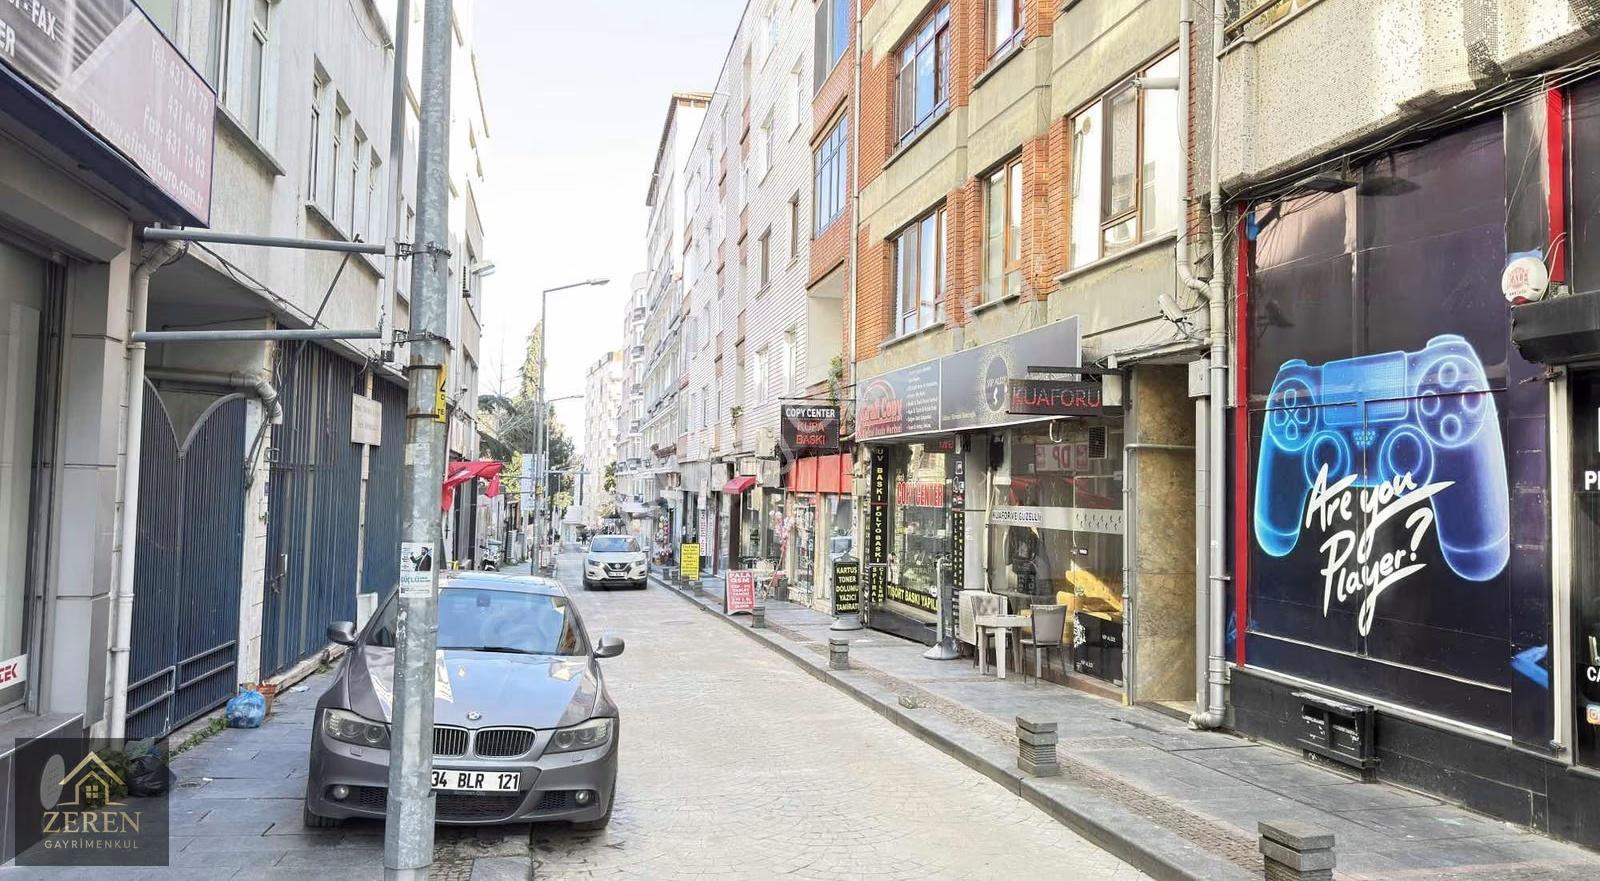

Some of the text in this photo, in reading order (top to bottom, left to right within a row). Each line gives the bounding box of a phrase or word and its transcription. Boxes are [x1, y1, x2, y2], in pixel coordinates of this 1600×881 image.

[32, 0, 56, 40] FAX
[785, 408, 836, 418] COPY CENTER
[797, 421, 825, 432] KUPA
[796, 434, 826, 445] BASKI
[896, 481, 944, 508] COPY CENTER
[1306, 463, 1456, 564] Are you
[838, 575, 857, 583] TONER
[1319, 507, 1433, 637] Player?
[431, 770, 519, 791] 34 BLR 121
